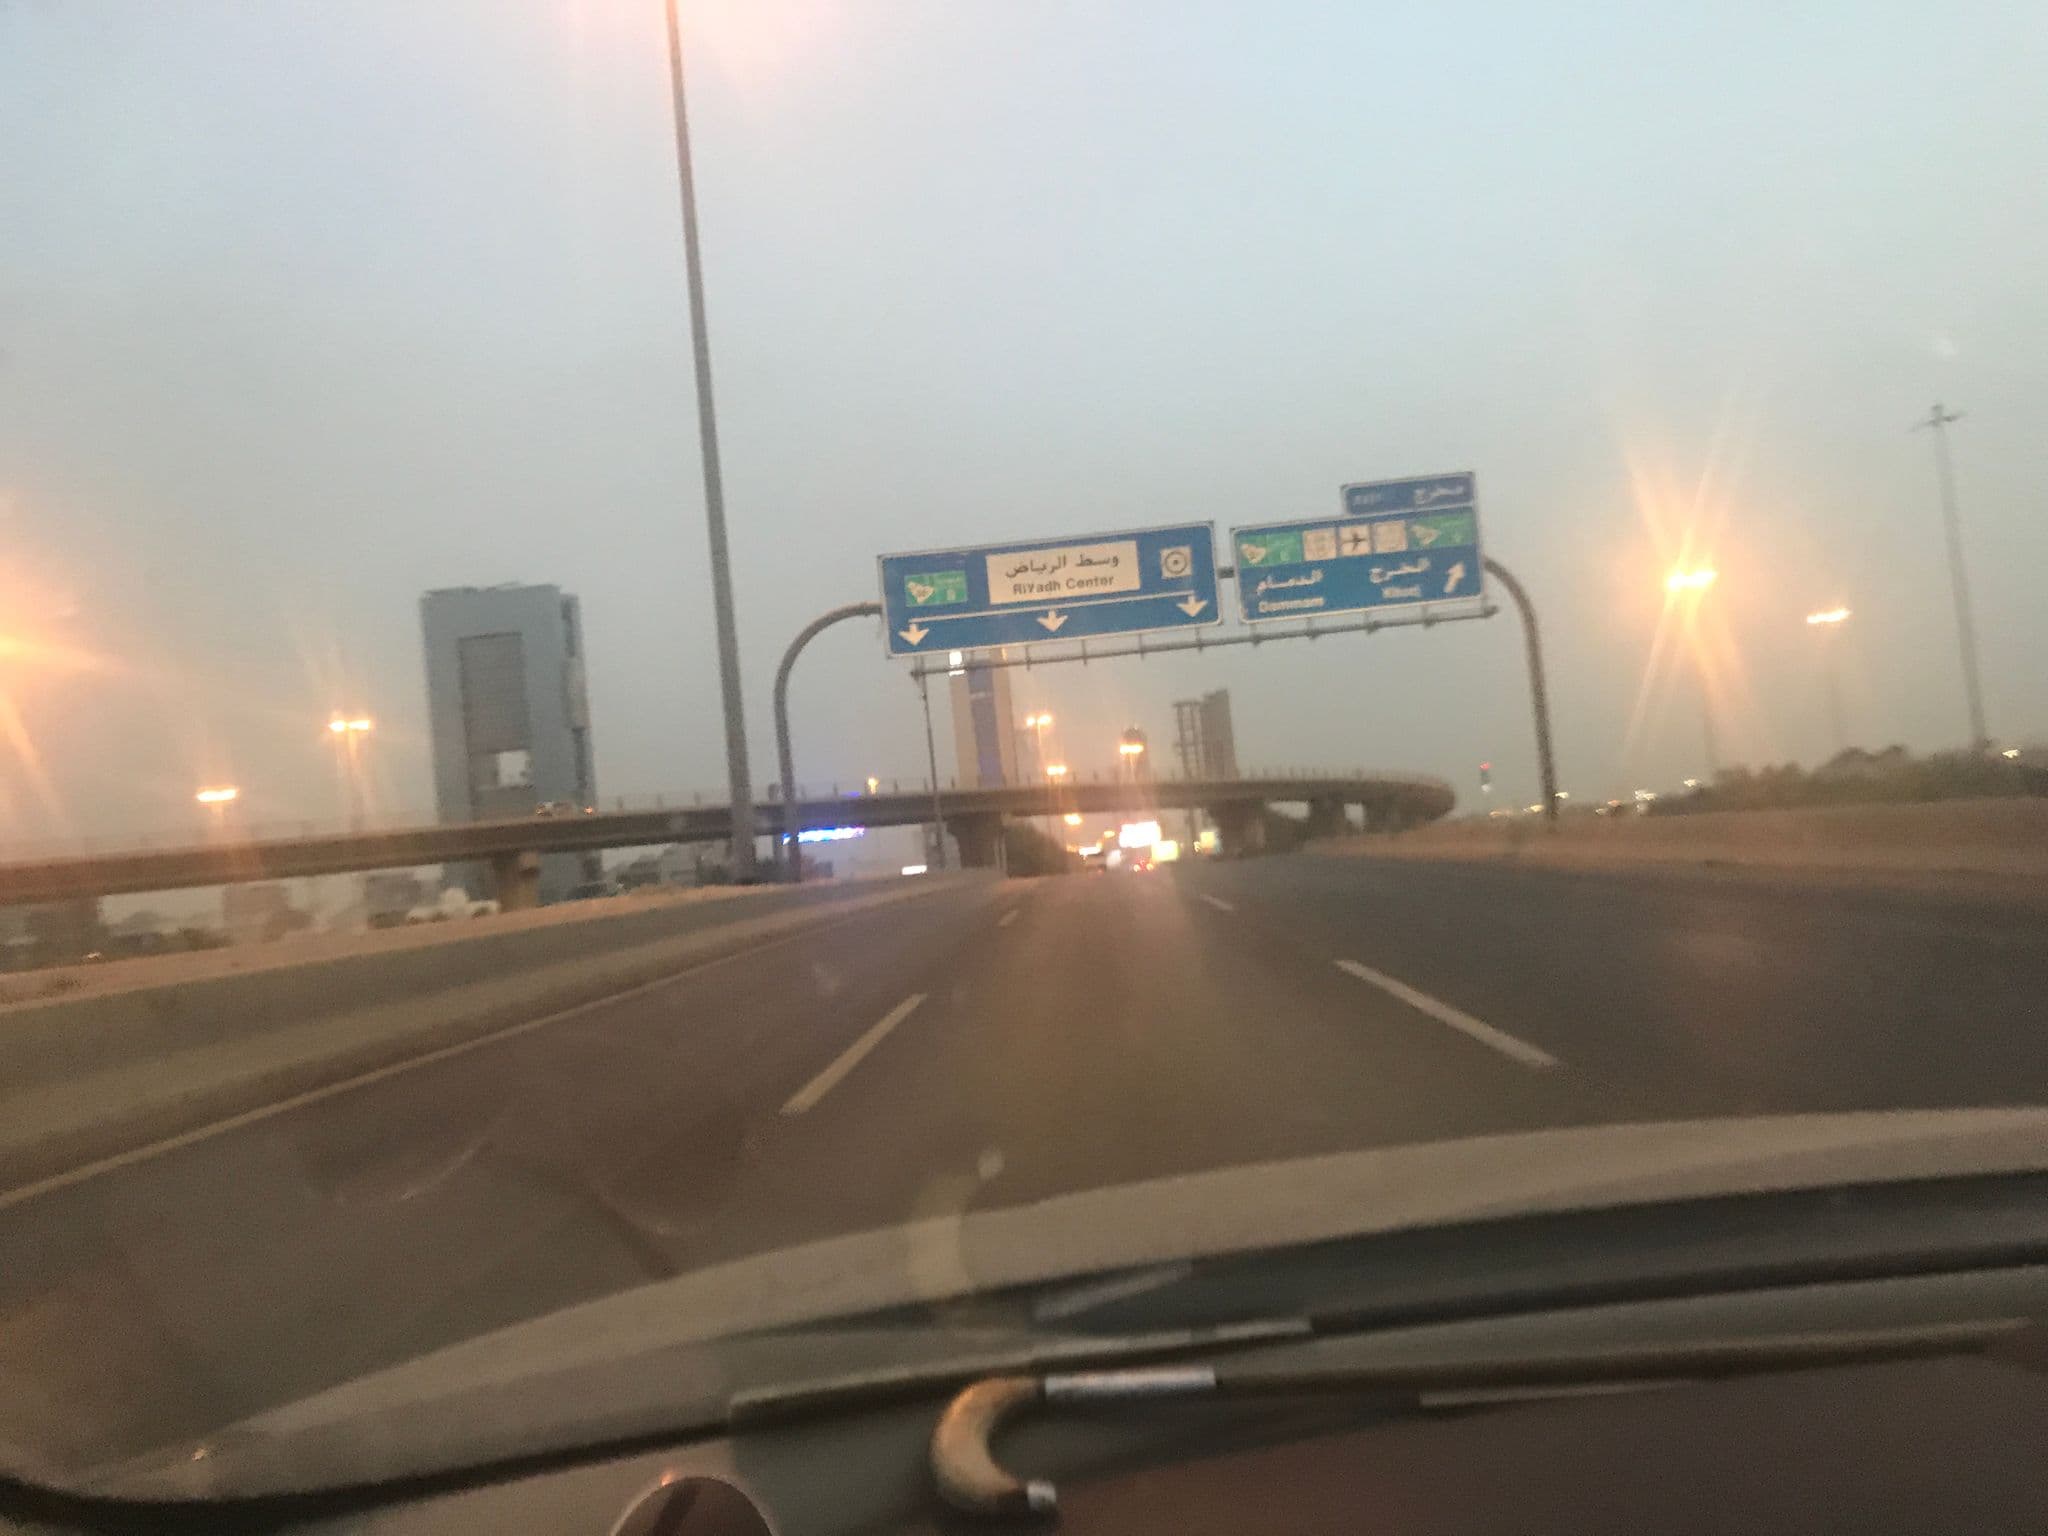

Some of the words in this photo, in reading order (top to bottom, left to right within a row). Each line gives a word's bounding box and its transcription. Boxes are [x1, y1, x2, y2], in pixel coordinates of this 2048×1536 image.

[1005, 554, 1067, 578] الرياض
[1075, 552, 1120, 568] وسط
[1066, 576, 1115, 590] Center
